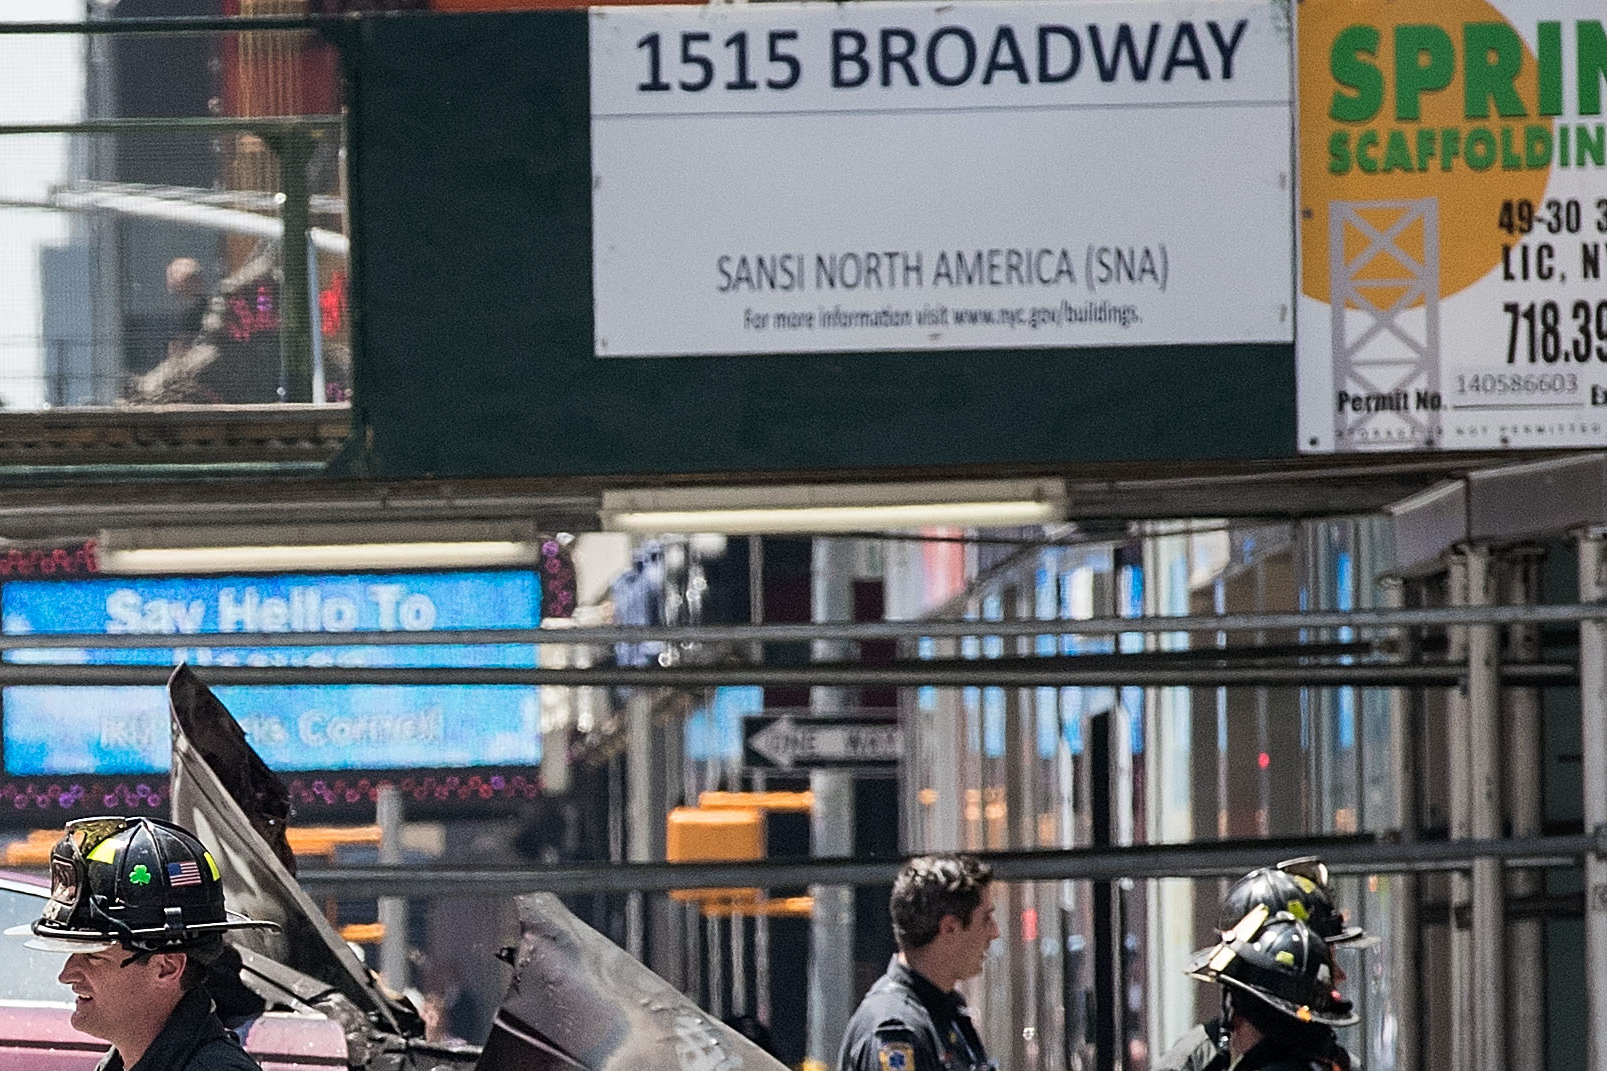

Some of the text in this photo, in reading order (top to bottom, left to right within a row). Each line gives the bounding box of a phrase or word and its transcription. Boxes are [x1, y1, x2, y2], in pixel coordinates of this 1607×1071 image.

[637, 18, 1248, 92] 1515 BROADWAY
[1498, 198, 1582, 235] 49-30
[717, 242, 1169, 292] SANSI NORTH AMERICA (SNA)
[1501, 242, 1567, 284] LIC,
[773, 311, 814, 329] more
[818, 304, 912, 328] information
[1337, 390, 1410, 414] Permit
[1415, 389, 1448, 411] No.
[1456, 373, 1579, 395] 140586603
[105, 583, 436, 634] Say Hello To
